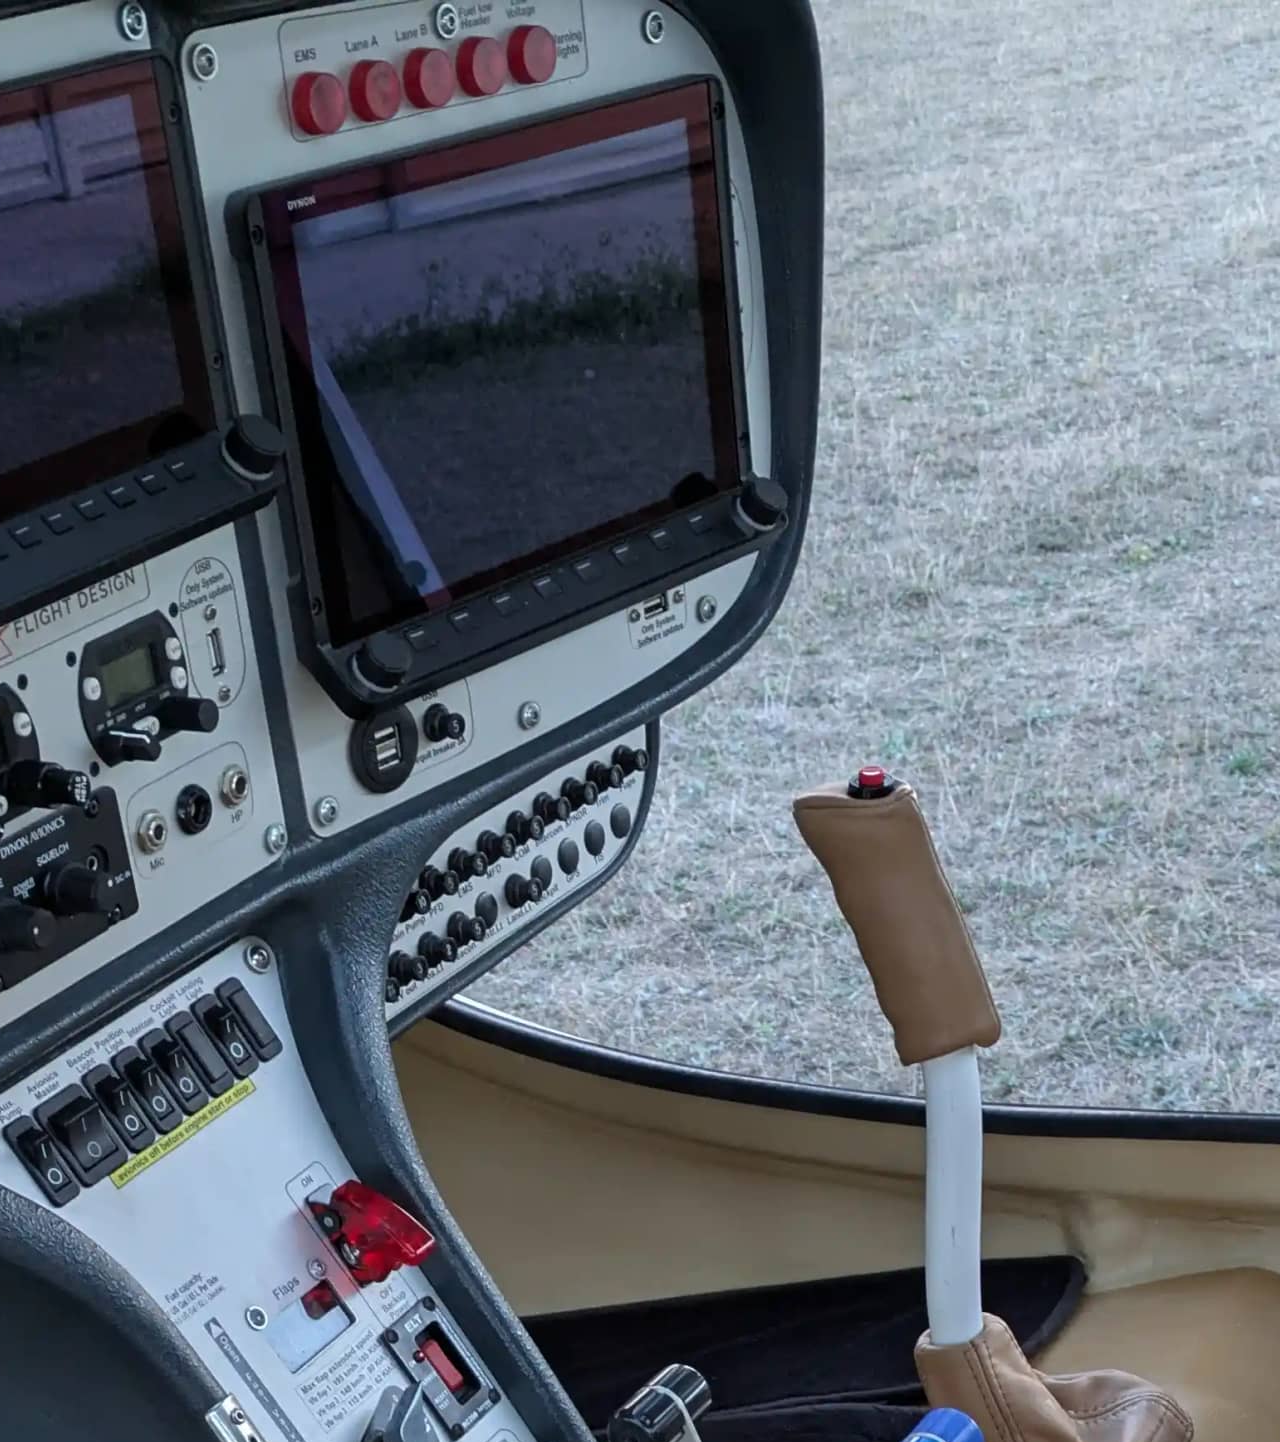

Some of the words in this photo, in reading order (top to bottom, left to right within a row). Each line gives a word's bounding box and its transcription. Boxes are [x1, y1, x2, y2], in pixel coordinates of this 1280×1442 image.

[395, 27, 418, 42] Lane
[419, 24, 428, 37] B
[552, 28, 583, 45] arning
[344, 37, 366, 53] Lane
[366, 35, 378, 48] A
[556, 43, 580, 58] ights
[294, 48, 317, 63] EMS
[287, 195, 316, 210] DYNON
[195, 560, 212, 575] USB
[185, 580, 200, 596] Only
[201, 571, 224, 590] System
[13, 600, 73, 639] FLIGHT
[76, 568, 137, 610] DESIGN
[179, 594, 207, 613] Software
[208, 582, 233, 601] updates
[230, 809, 243, 824] HP
[0, 834, 30, 859] DYNON
[29, 815, 66, 844] AVIONICS
[36, 841, 70, 867] SQUELCH
[513, 846, 531, 862] COM
[149, 857, 165, 872] Mic
[176, 976, 204, 998] Landing
[186, 987, 203, 1002] Light
[149, 992, 176, 1013] Cockpit
[159, 1003, 178, 1019] Light
[126, 1017, 155, 1038] Intercom
[94, 1027, 125, 1050] Position
[105, 1038, 125, 1055] Light
[66, 1048, 92, 1069] Beacon
[76, 1058, 97, 1074] Light
[26, 1070, 59, 1094] Avionics
[34, 1081, 61, 1101] Master
[0, 1106, 24, 1124] Pump
[118, 1157, 150, 1182] avionics
[150, 1145, 161, 1158] off
[160, 1129, 185, 1151] before
[185, 1113, 208, 1136] engine
[207, 1103, 225, 1121] start
[224, 1095, 234, 1105] or
[233, 1084, 250, 1101] stop
[301, 1175, 314, 1188] ON
[164, 1288, 180, 1303] Fuel
[271, 1276, 301, 1302] Flaps
[379, 1284, 395, 1300] OFF
[381, 1290, 407, 1314] Backup
[404, 1313, 424, 1334] ELT
[219, 1334, 241, 1363] Open
[300, 1380, 316, 1394] Max
[313, 1369, 329, 1384] flap
[326, 1347, 356, 1373] extended
[353, 1330, 375, 1350] speed
